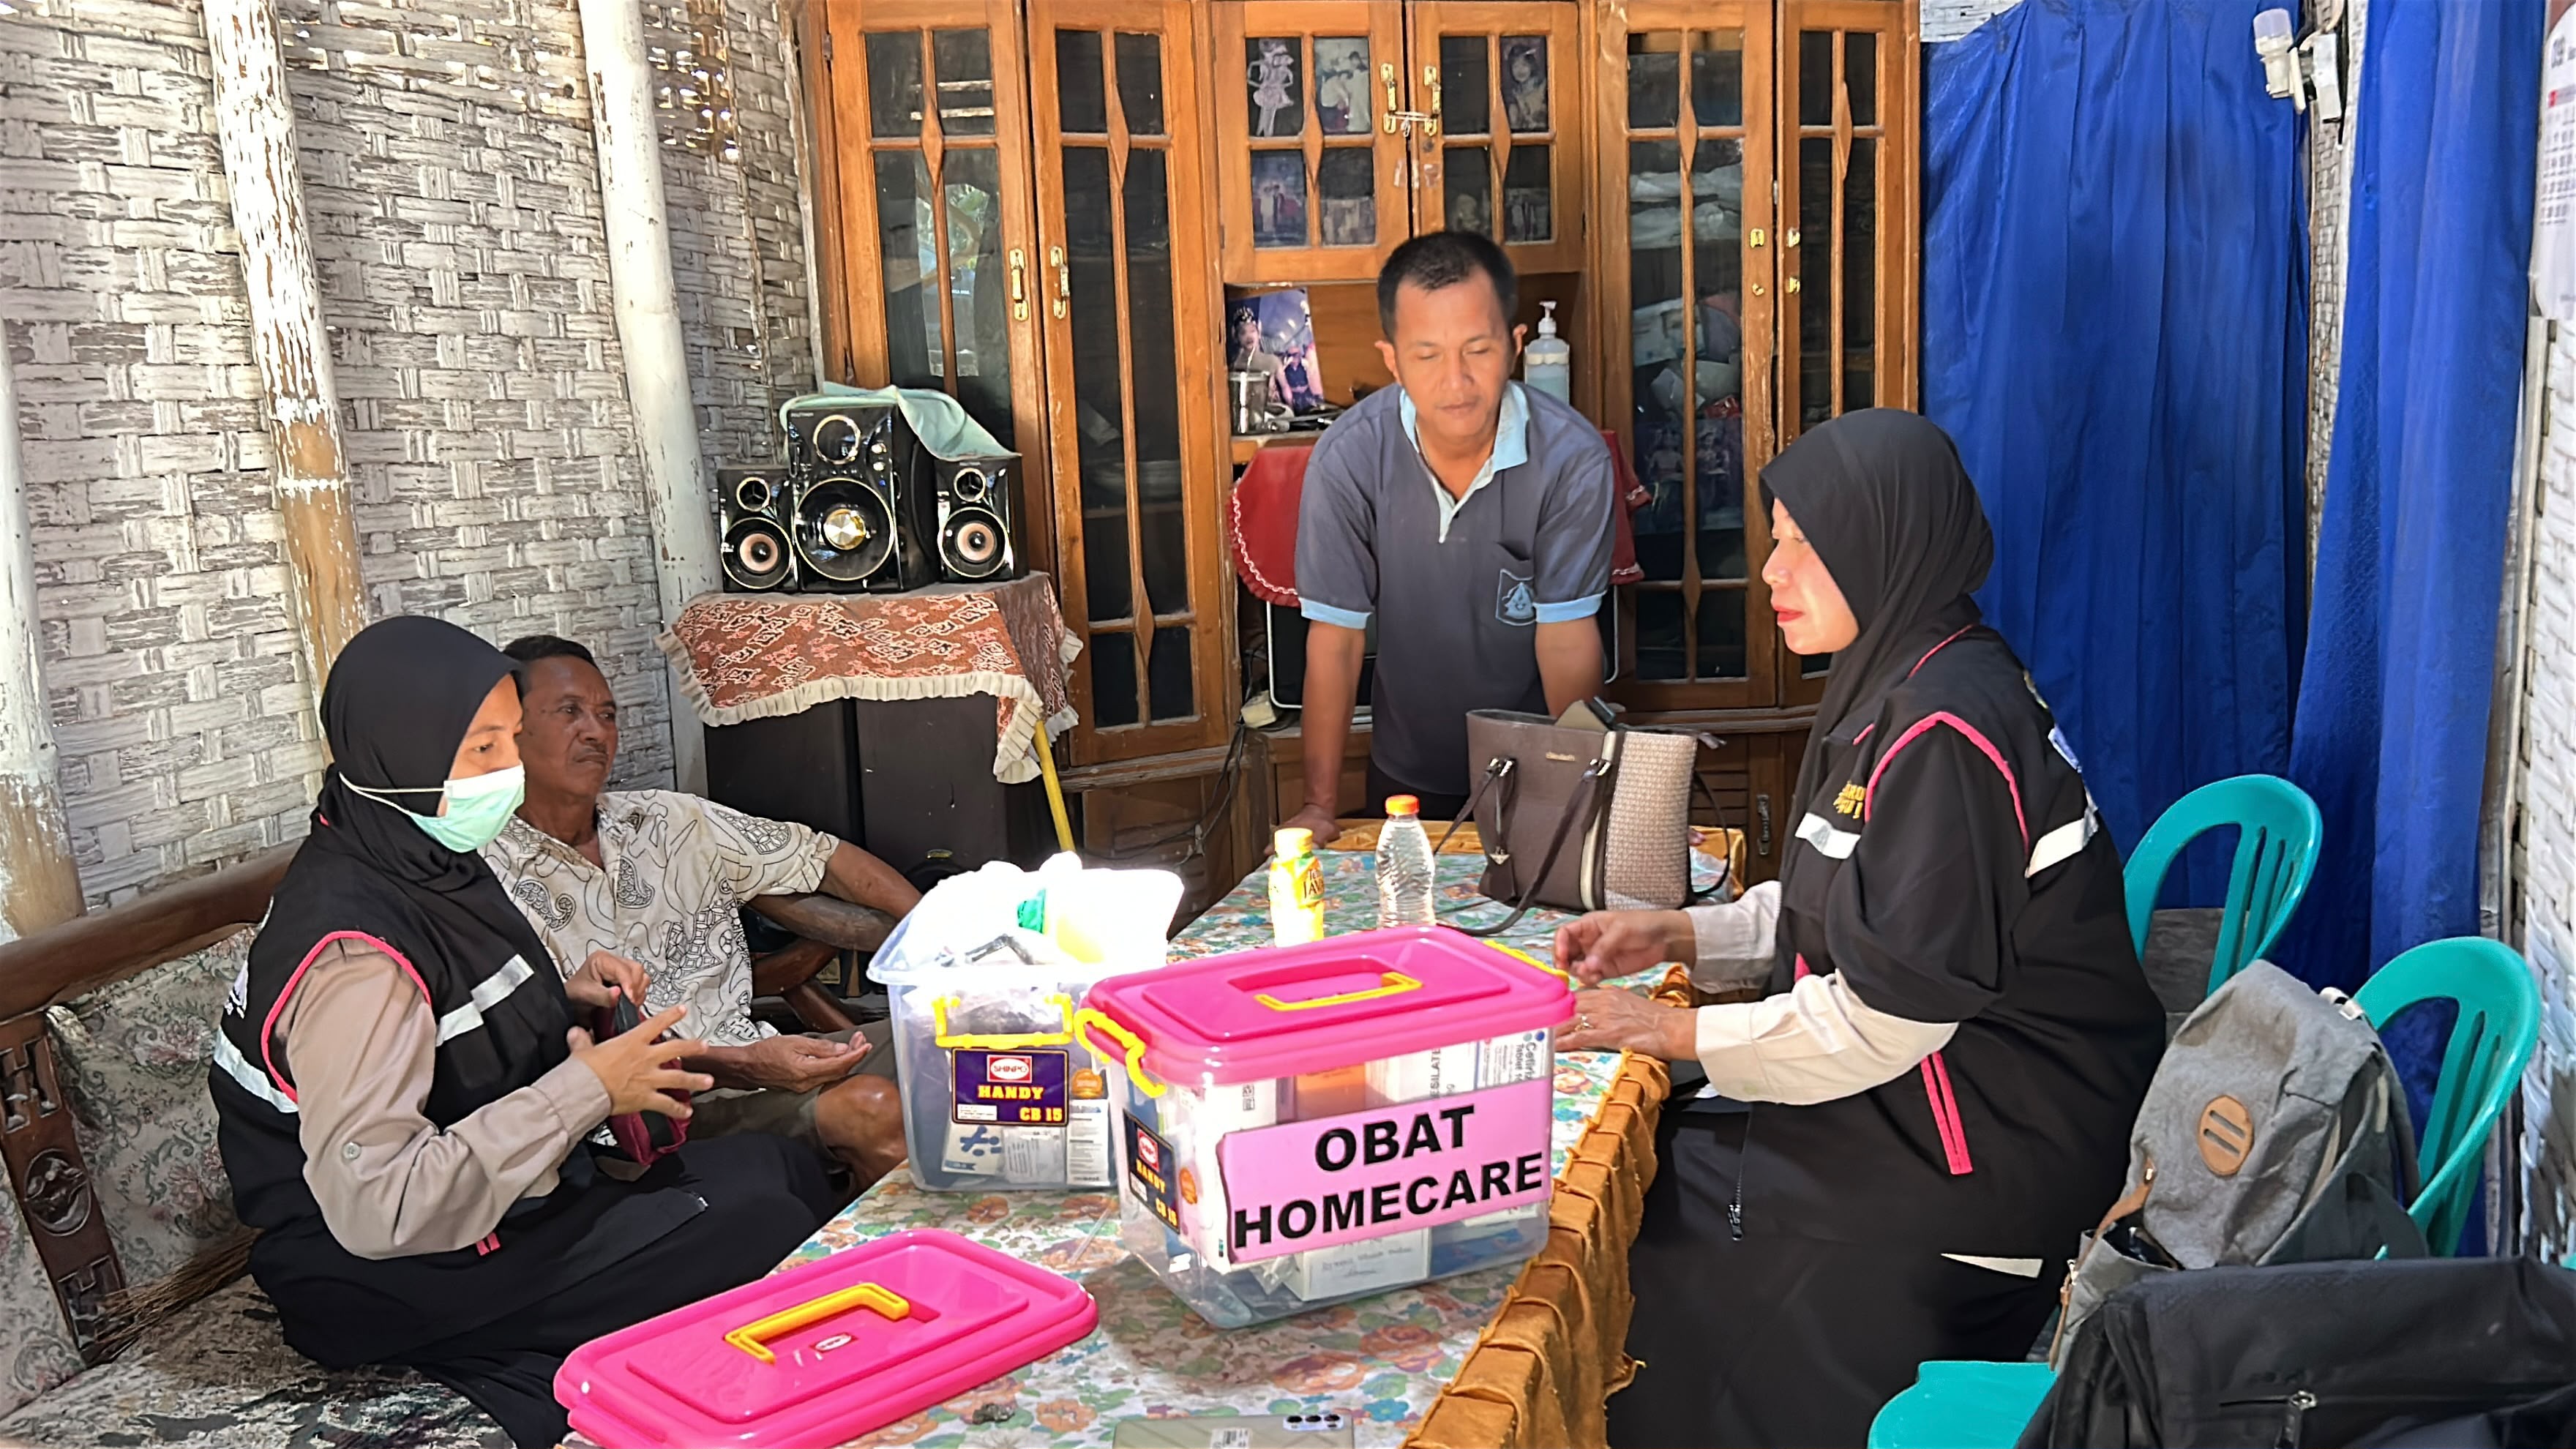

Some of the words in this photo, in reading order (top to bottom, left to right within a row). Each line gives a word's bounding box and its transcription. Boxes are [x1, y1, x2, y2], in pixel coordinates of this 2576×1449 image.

[978, 1085, 1044, 1100] HANDY
[1019, 1107, 1041, 1121] CB
[1046, 1107, 1063, 1122] 15
[1316, 1106, 1475, 1172] OBAT
[1234, 1152, 1543, 1248] HOMECARE
